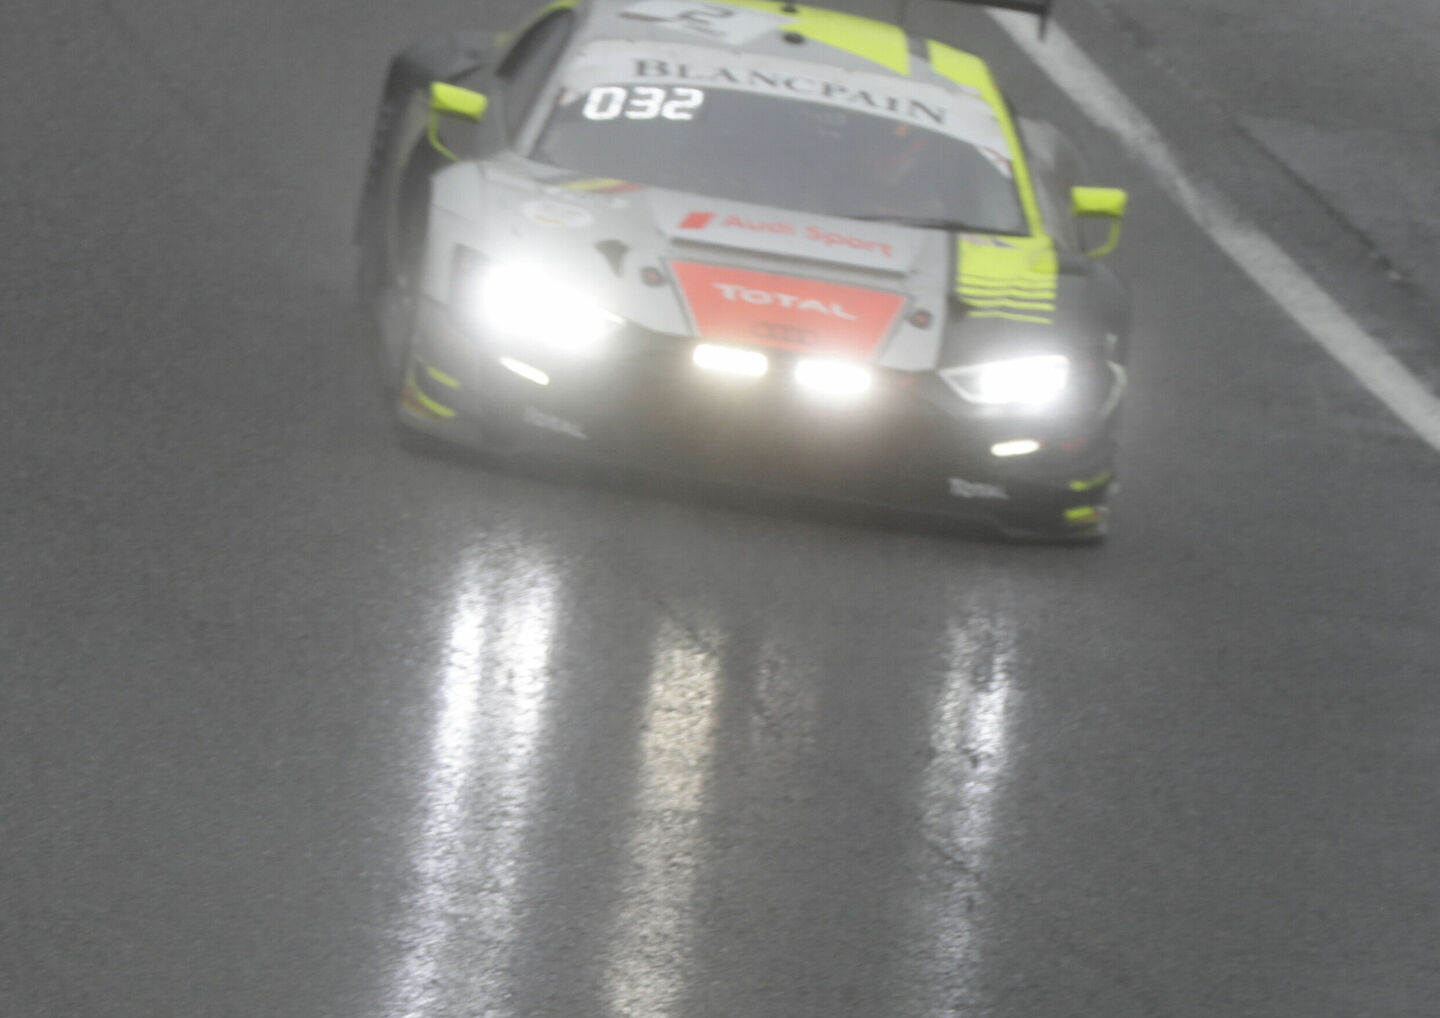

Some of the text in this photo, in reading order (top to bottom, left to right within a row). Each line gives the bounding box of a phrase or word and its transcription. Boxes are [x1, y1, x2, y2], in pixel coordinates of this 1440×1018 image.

[581, 85, 704, 121] 032
[633, 57, 947, 125] BLANCPAIN
[721, 212, 895, 259] Audi Sport
[712, 280, 858, 321] TOTAL
